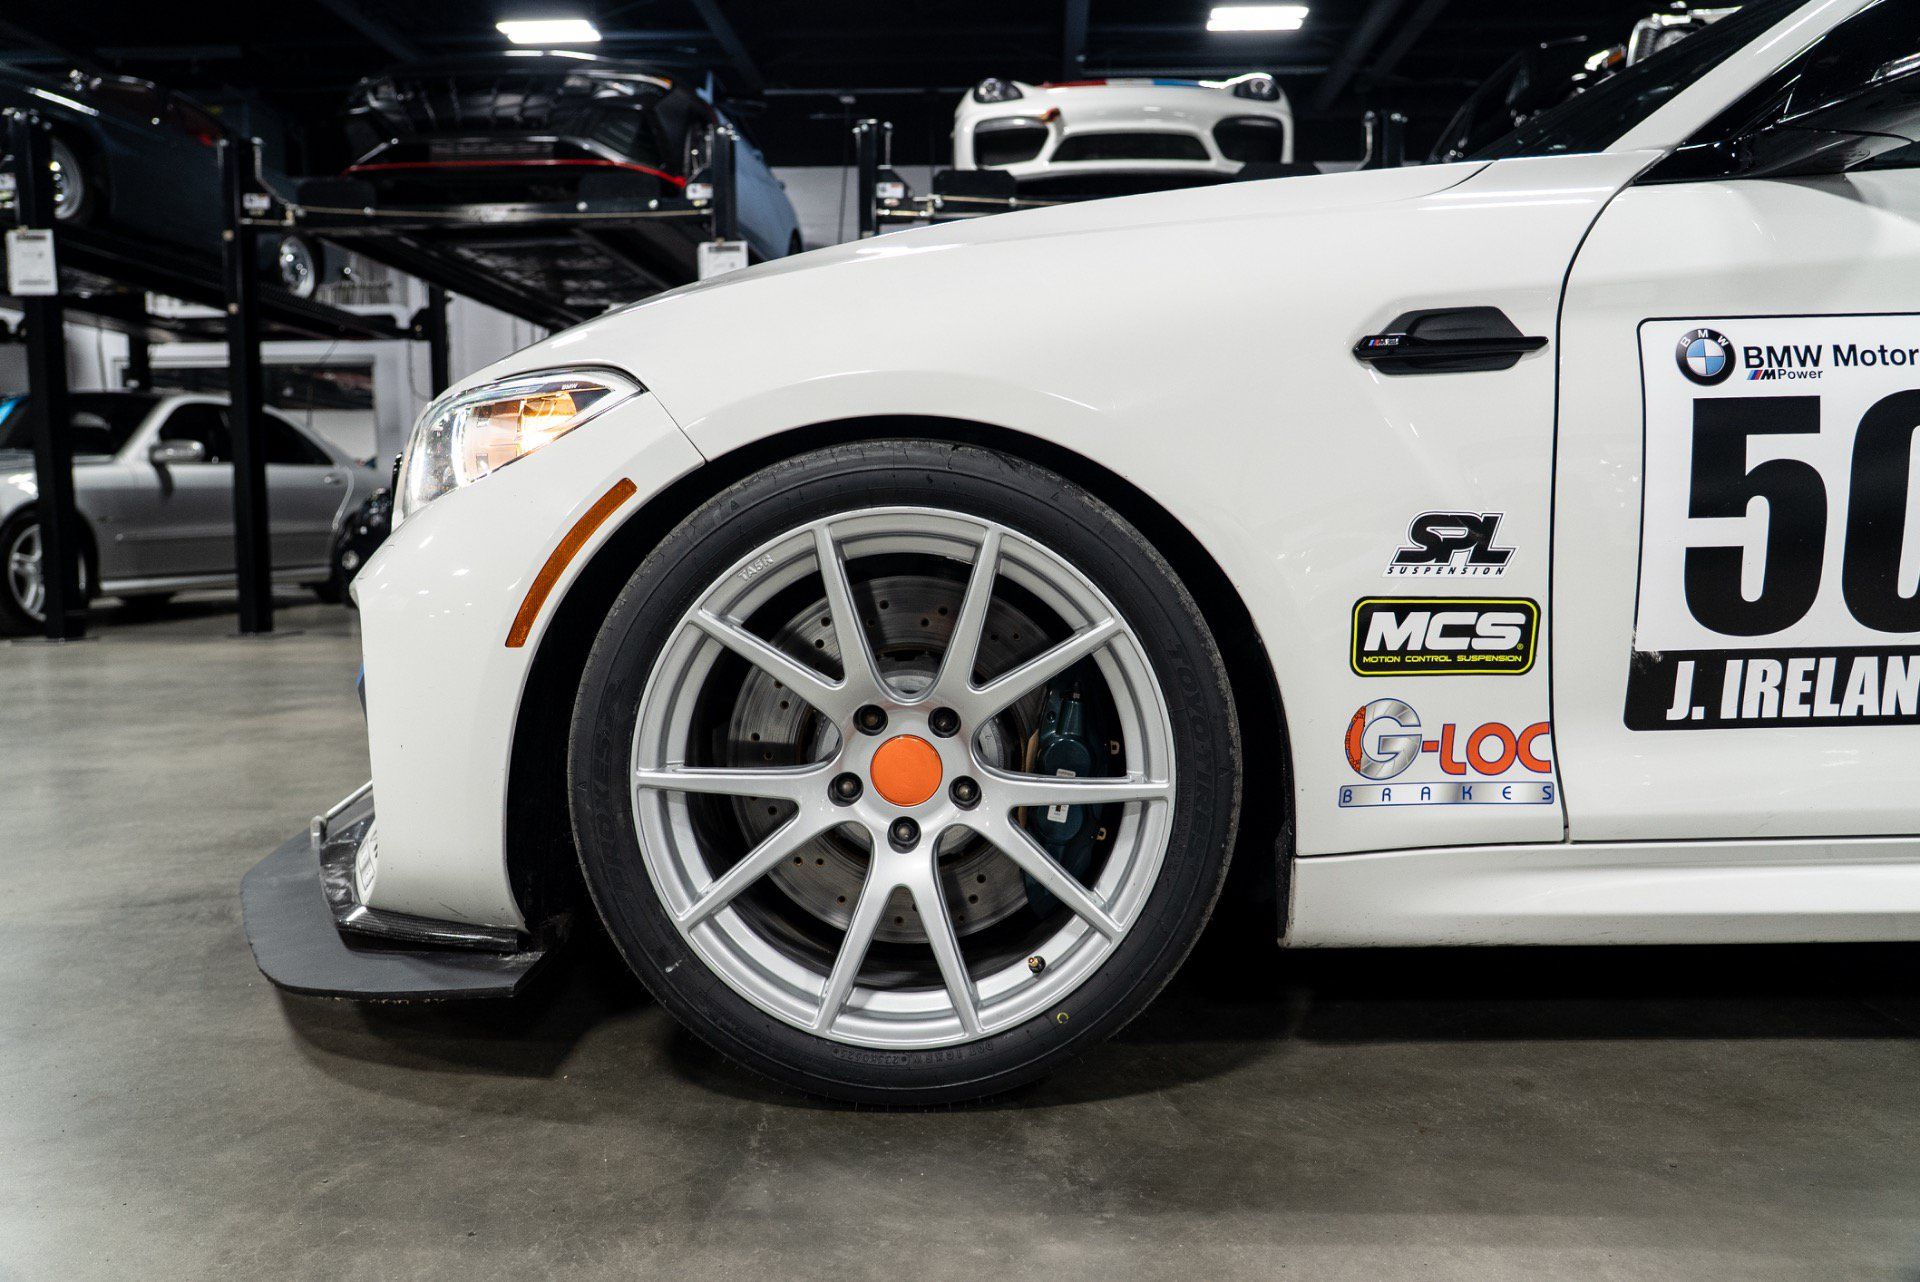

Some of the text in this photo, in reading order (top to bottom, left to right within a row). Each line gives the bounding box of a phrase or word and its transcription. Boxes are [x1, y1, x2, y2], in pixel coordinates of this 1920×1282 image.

[1681, 329, 1729, 347] BMW
[1743, 343, 1920, 369] BMW Motor
[1391, 512, 1516, 566] SPL
[1387, 566, 1505, 575] SUSPENSION
[1363, 611, 1526, 651] MCS
[1363, 655, 1401, 663] MOTION
[1457, 654, 1522, 662] SUSPENSION
[1666, 654, 1920, 721] J. IRELAN
[1344, 697, 1553, 781] G-LOC
[1342, 785, 1552, 803] BRAKES
